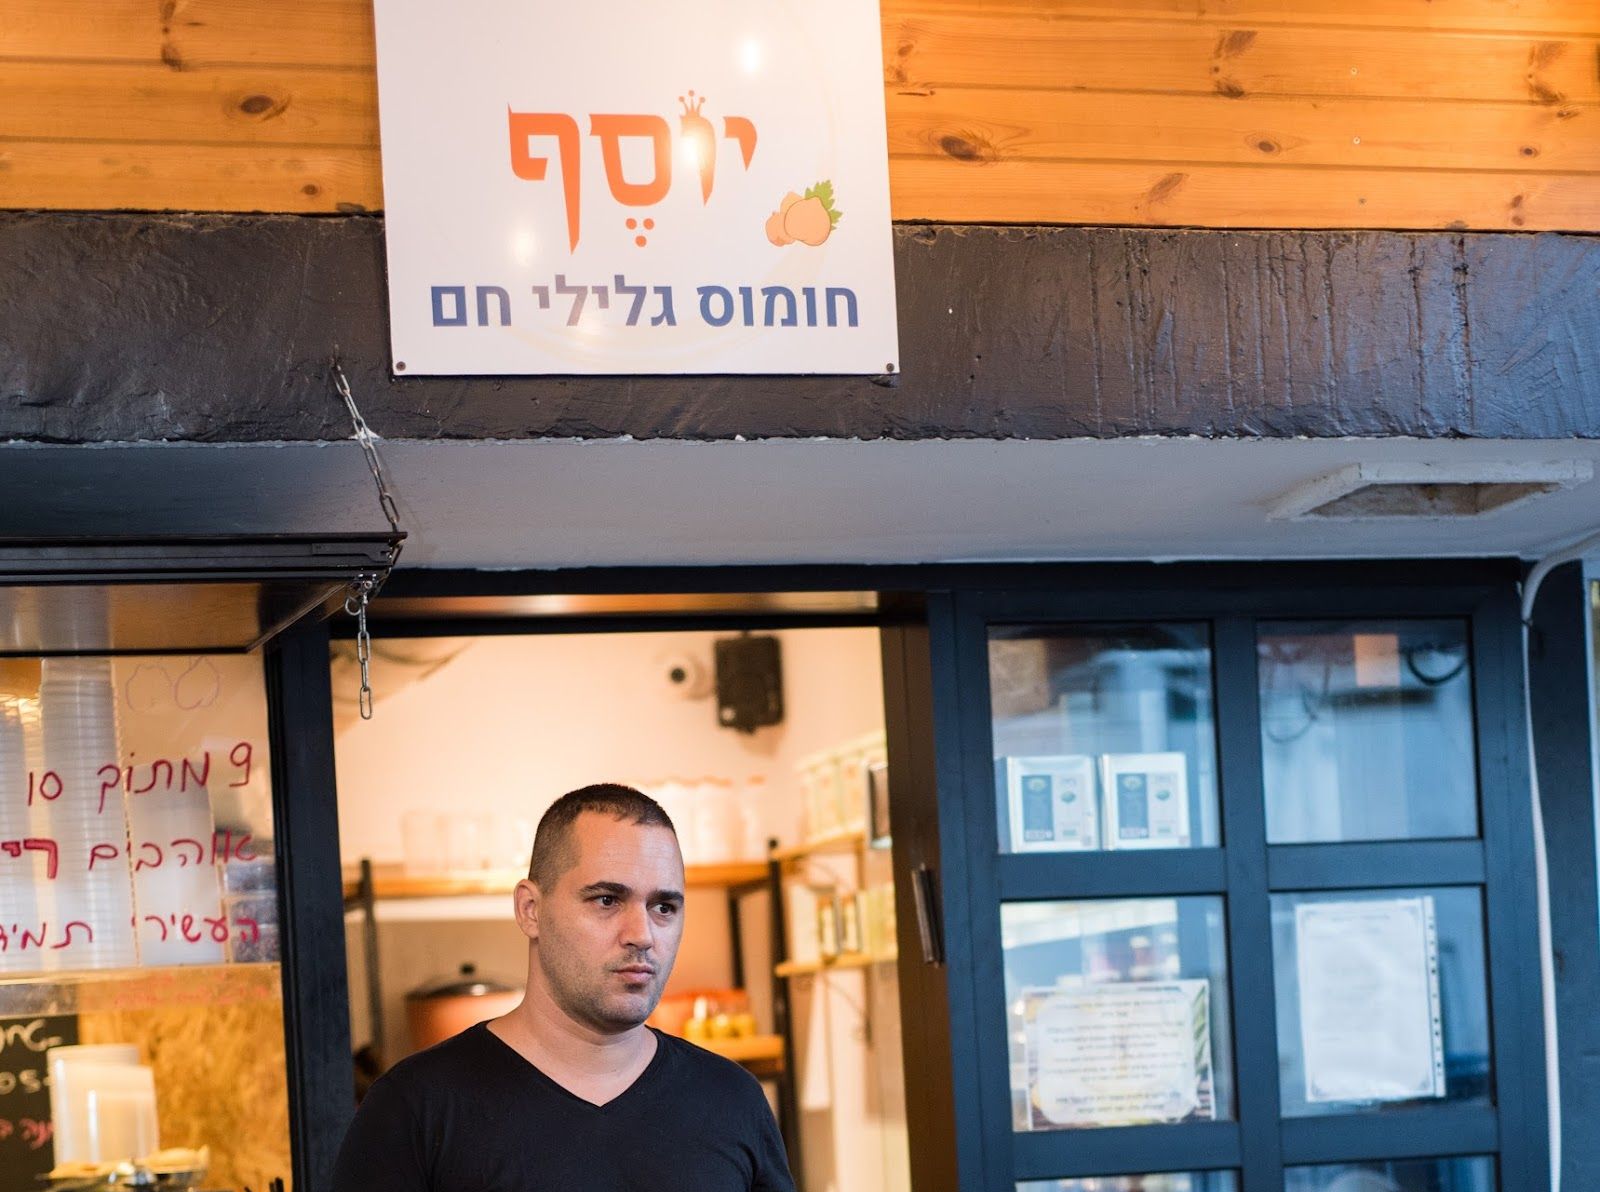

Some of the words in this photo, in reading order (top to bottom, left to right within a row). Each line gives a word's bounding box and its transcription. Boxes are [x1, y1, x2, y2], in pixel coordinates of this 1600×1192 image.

[430, 286, 511, 327] חם
[532, 274, 676, 327] גלילי
[696, 285, 859, 327] חומוס
[97, 752, 209, 814] מתוך
[88, 830, 256, 871] אוהבים
[131, 914, 259, 942] העשירי
